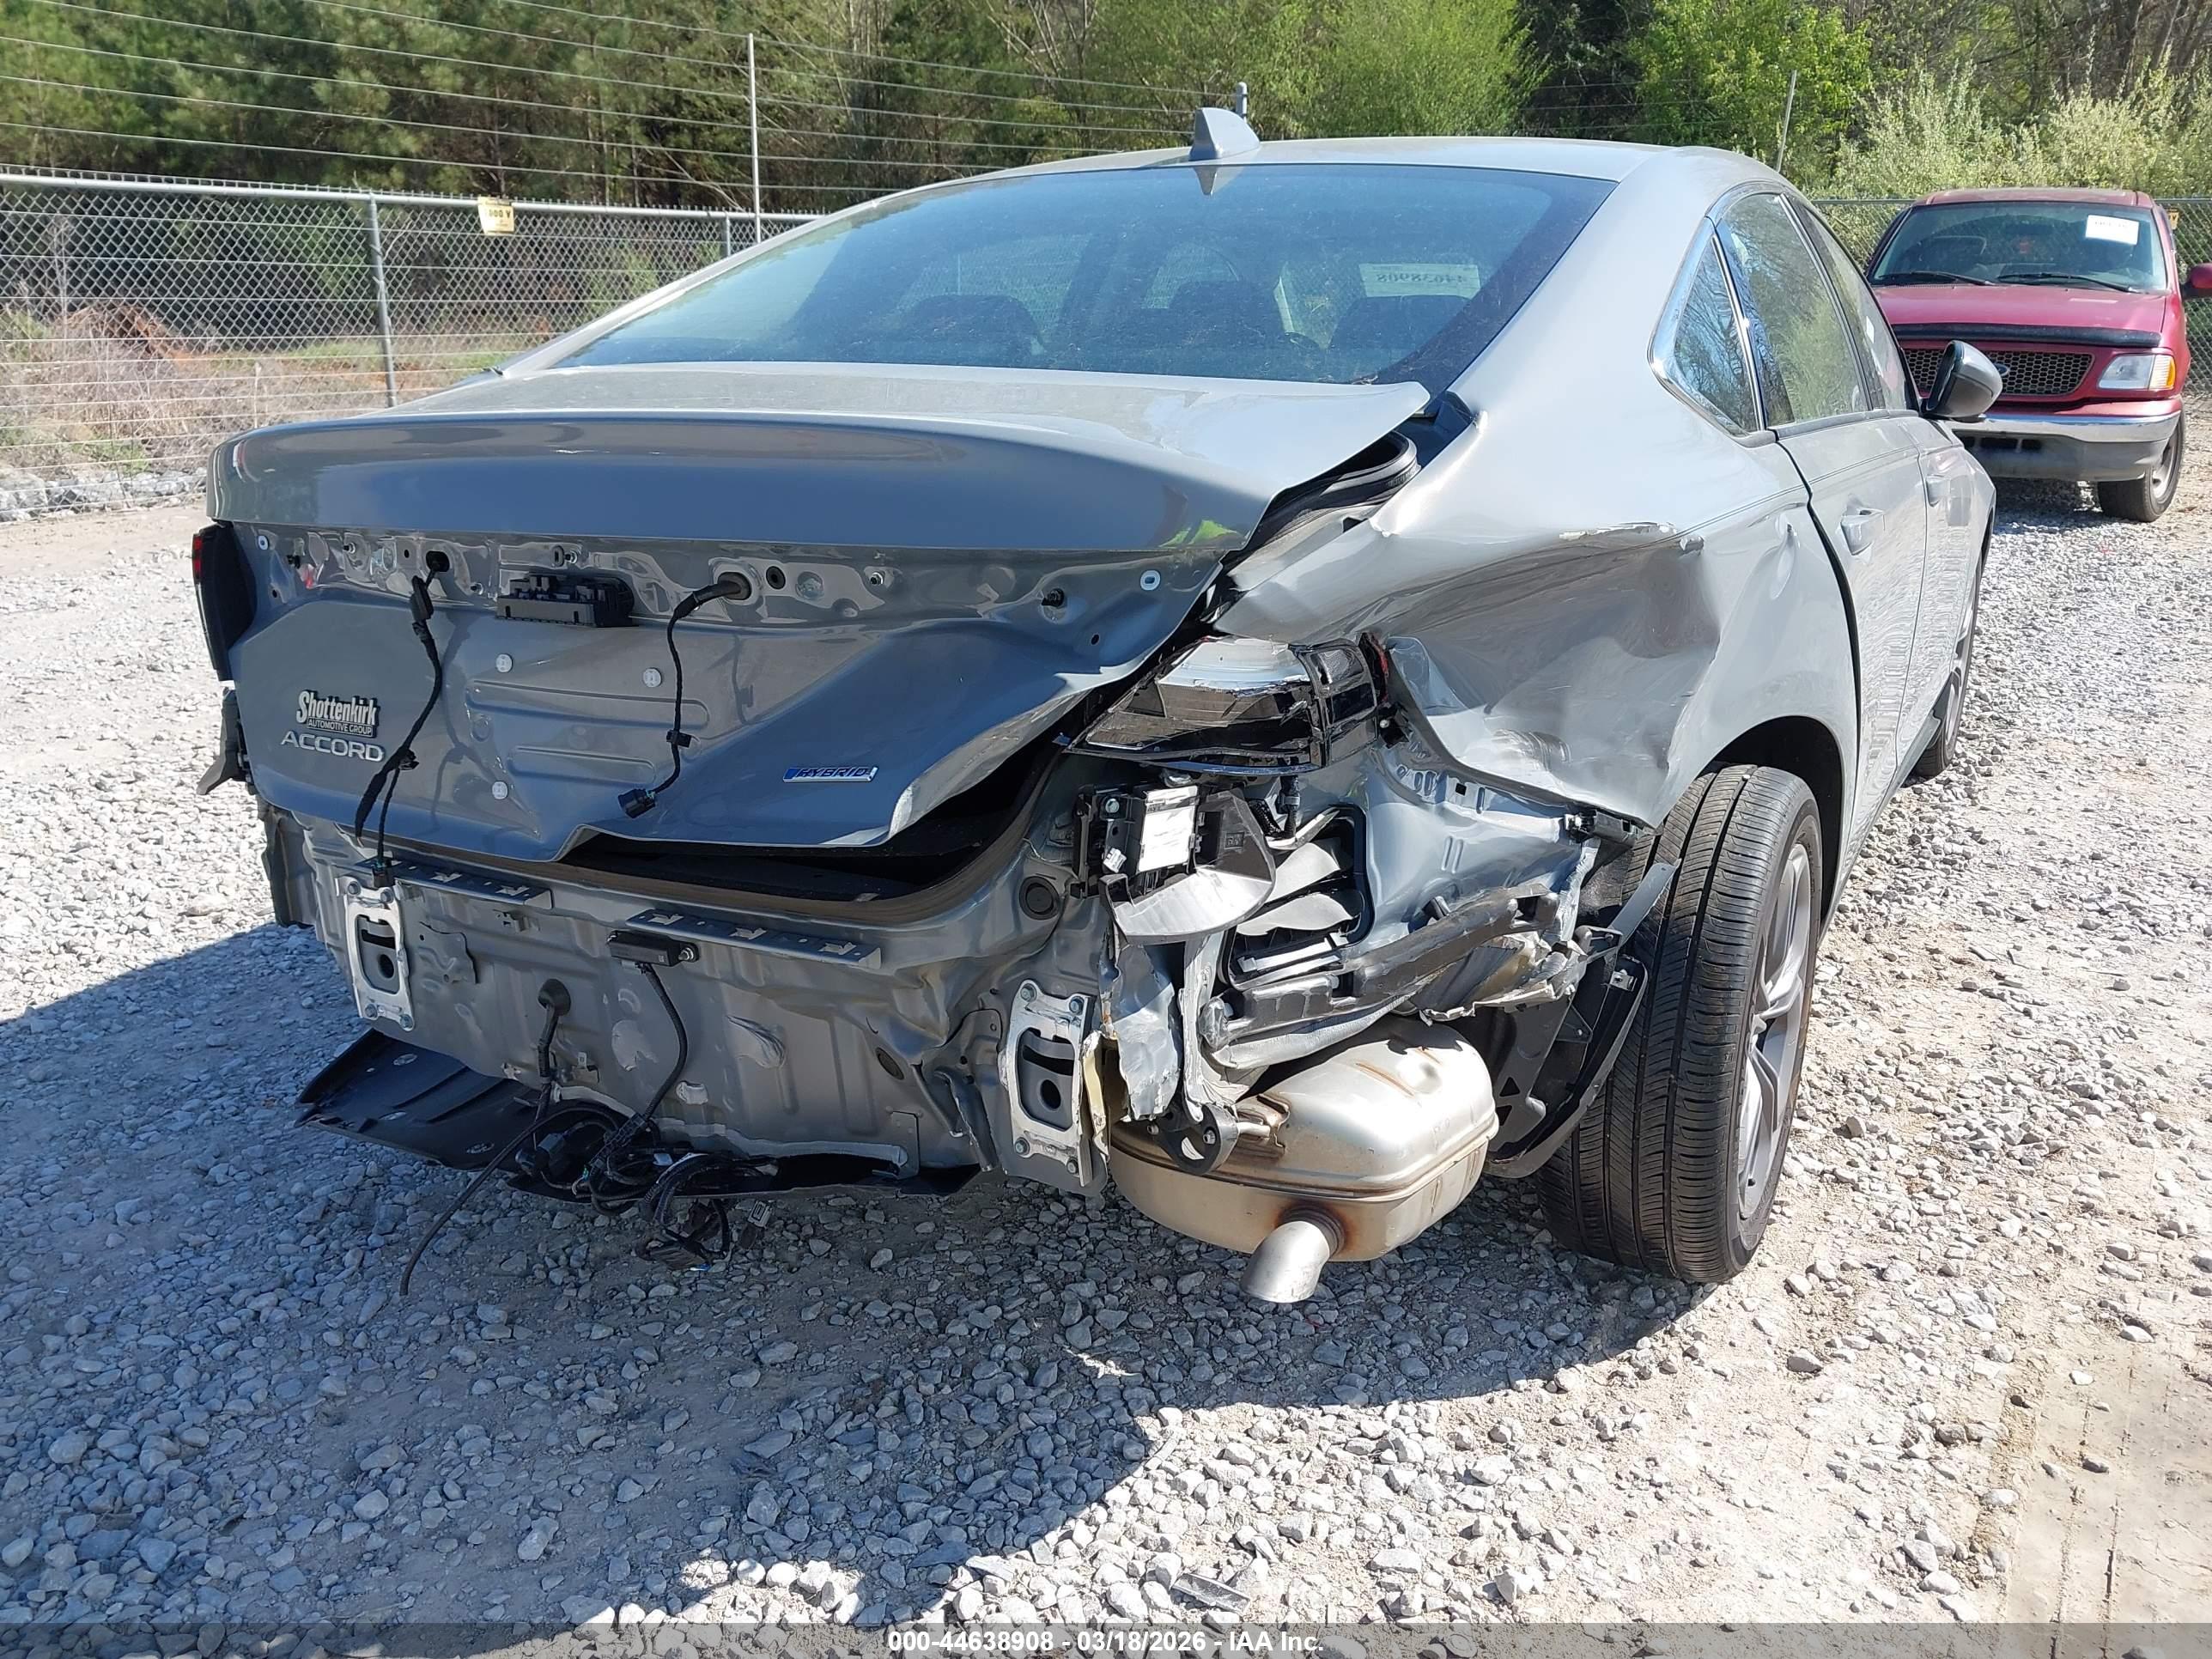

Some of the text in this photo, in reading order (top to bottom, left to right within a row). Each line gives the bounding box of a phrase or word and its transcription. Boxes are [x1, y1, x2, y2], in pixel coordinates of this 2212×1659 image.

[295, 690, 377, 726] Shottenkirk
[308, 719, 373, 735] AUTOMOTIVE GROUP
[281, 730, 385, 762] ACCORD
[795, 767, 871, 778] HYBRID
